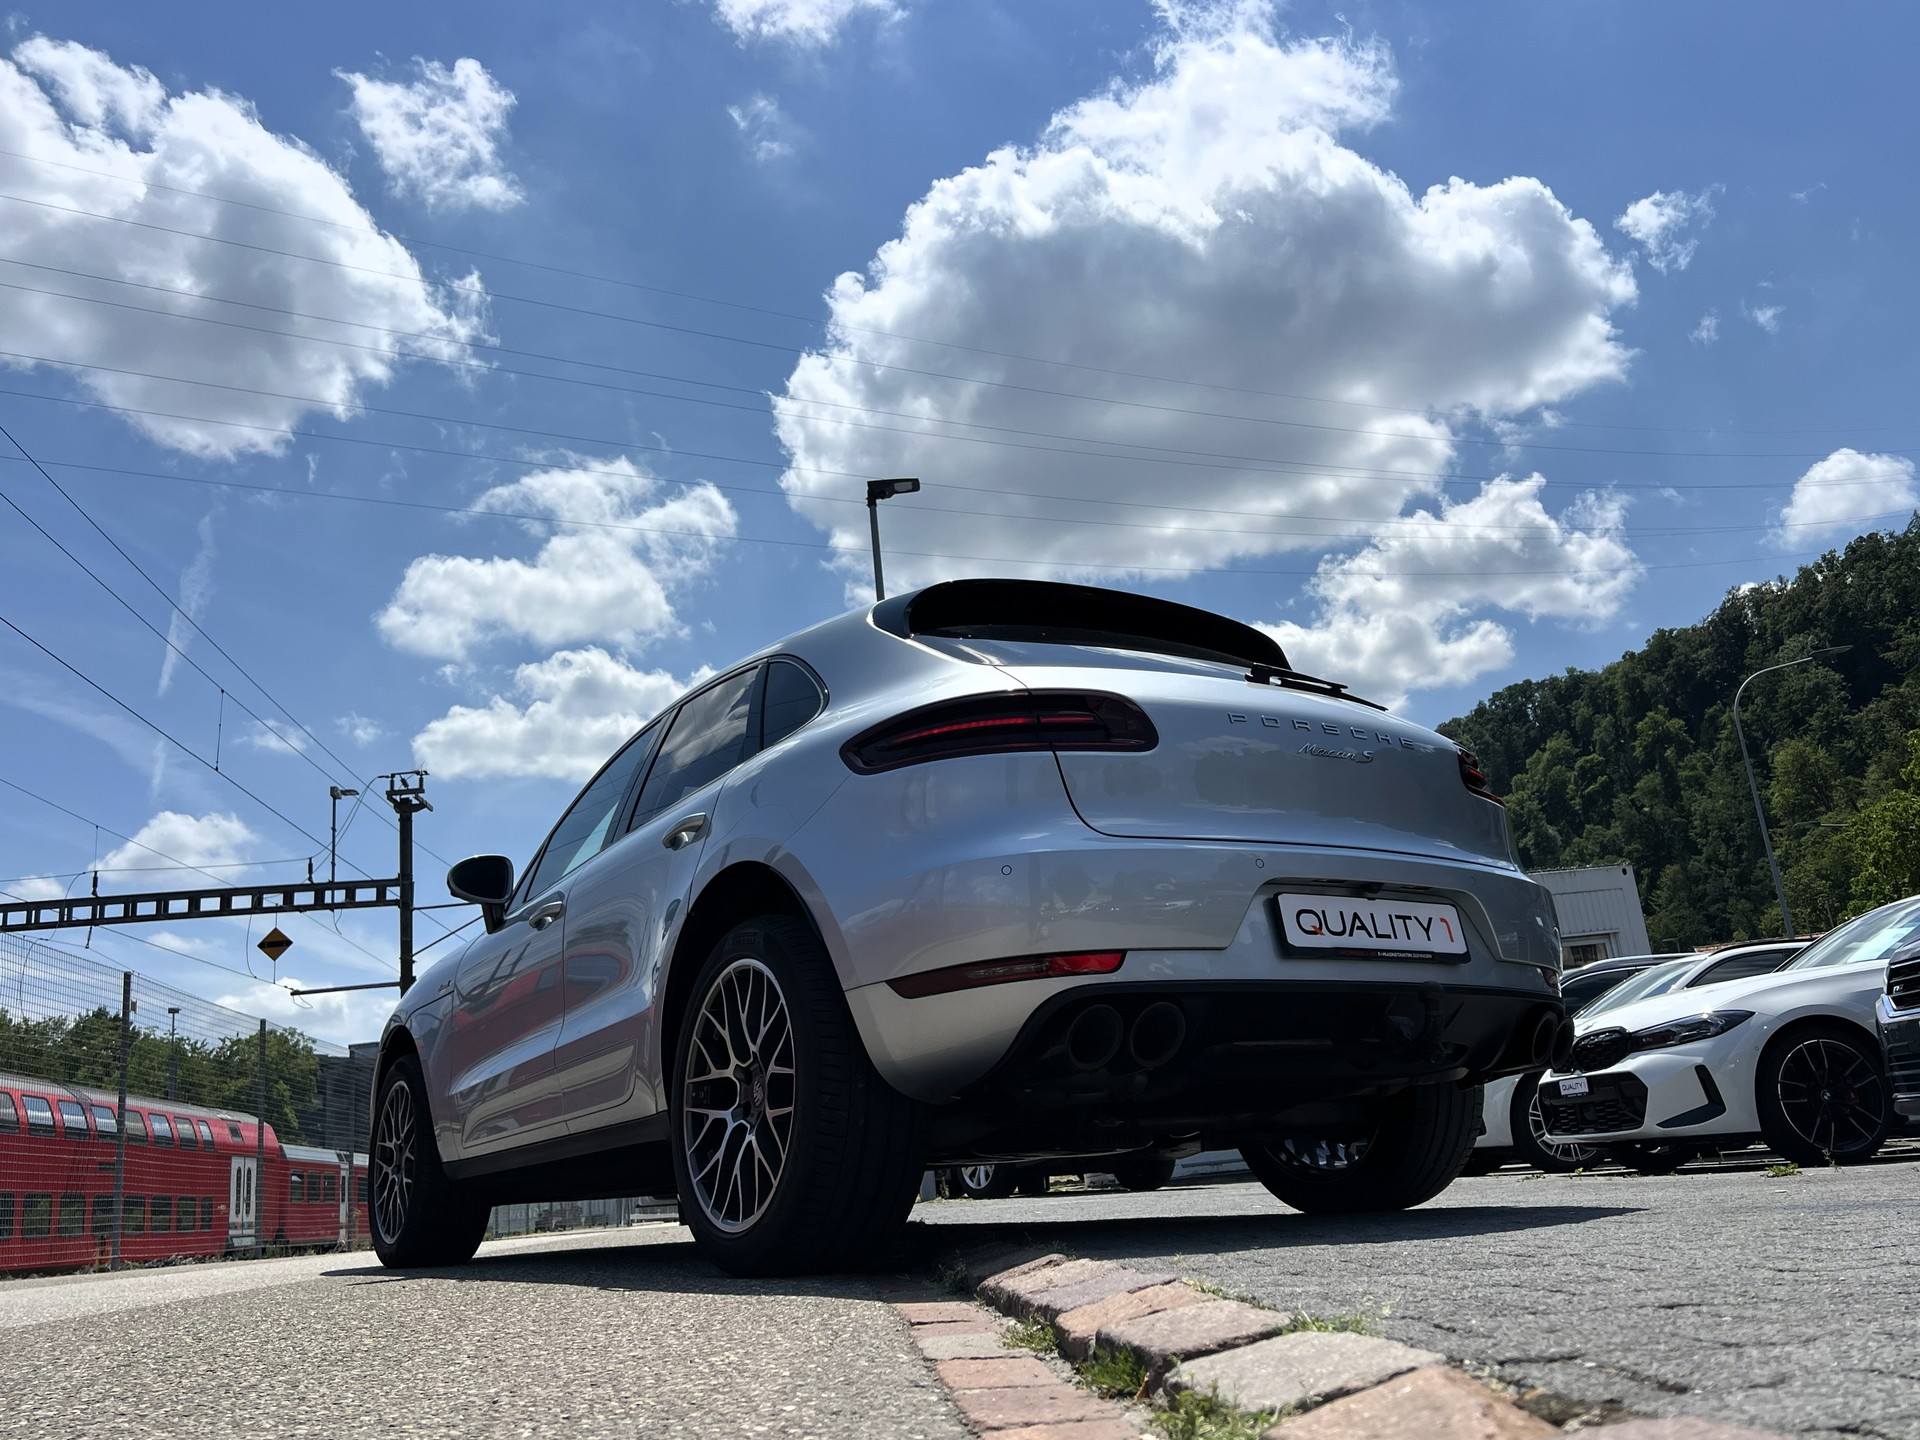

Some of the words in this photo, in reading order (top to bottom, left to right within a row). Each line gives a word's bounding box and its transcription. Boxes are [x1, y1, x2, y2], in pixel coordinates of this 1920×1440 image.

[1228, 711, 1415, 750] PORSCHE
[1298, 743, 1356, 761] Macan
[1355, 750, 1374, 763] S
[1296, 908, 1432, 941] QUALITY
[1562, 1082, 1582, 1091] QUALITY
